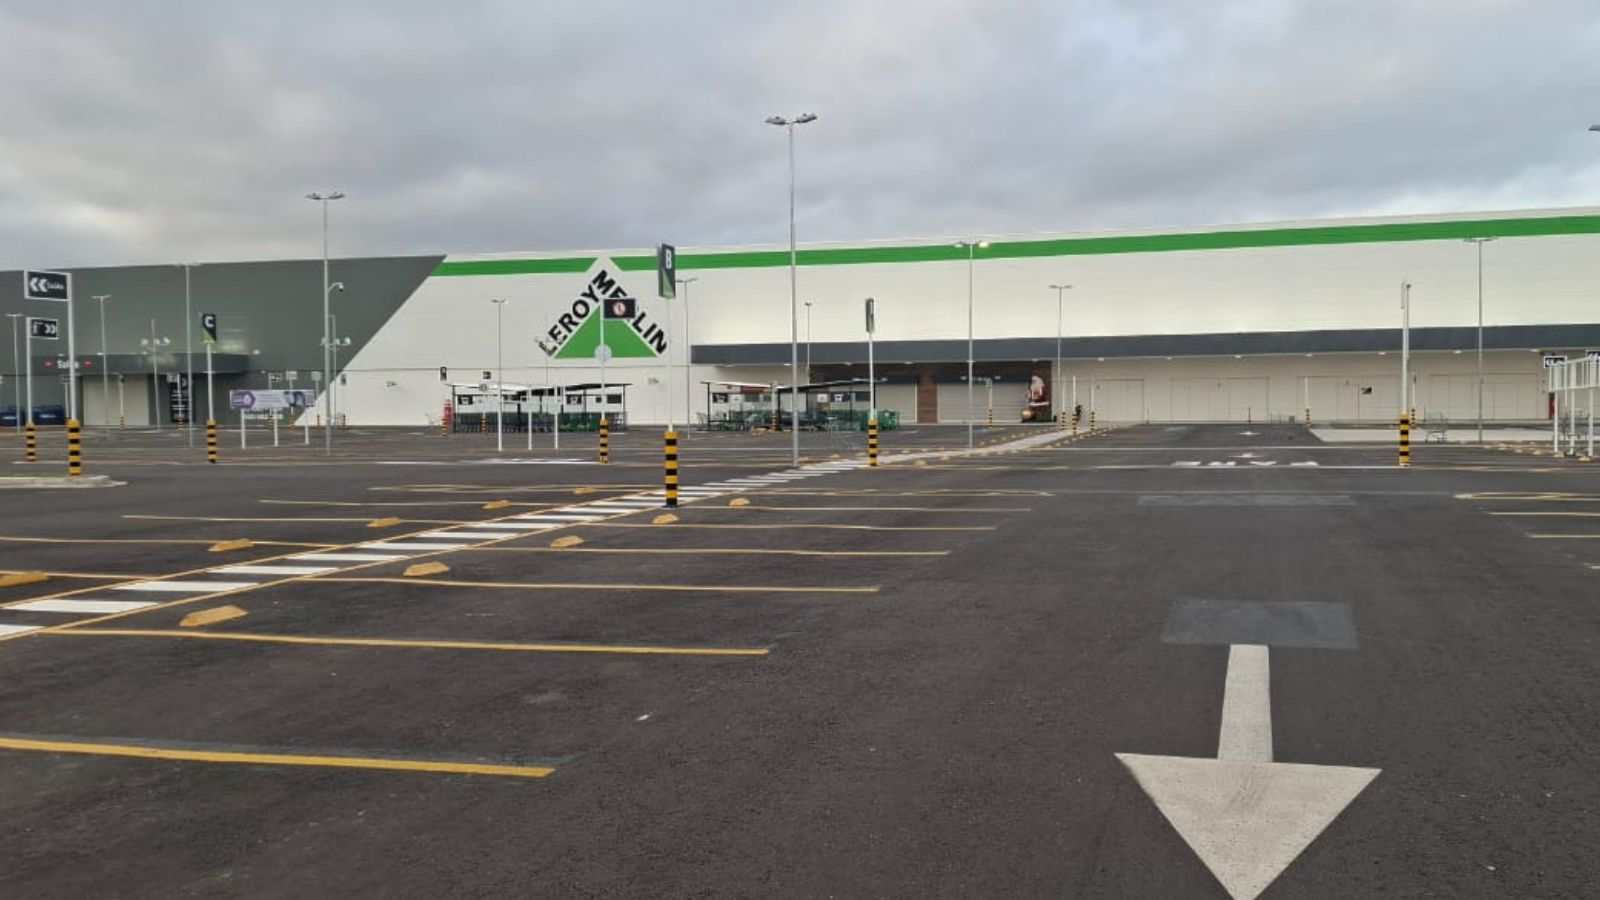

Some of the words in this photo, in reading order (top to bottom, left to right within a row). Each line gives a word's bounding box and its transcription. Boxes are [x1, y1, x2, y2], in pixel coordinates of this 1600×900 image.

[665, 249, 672, 269] B
[204, 316, 214, 328] C
[538, 284, 599, 357] LEROY
[592, 270, 667, 354] MELIN
